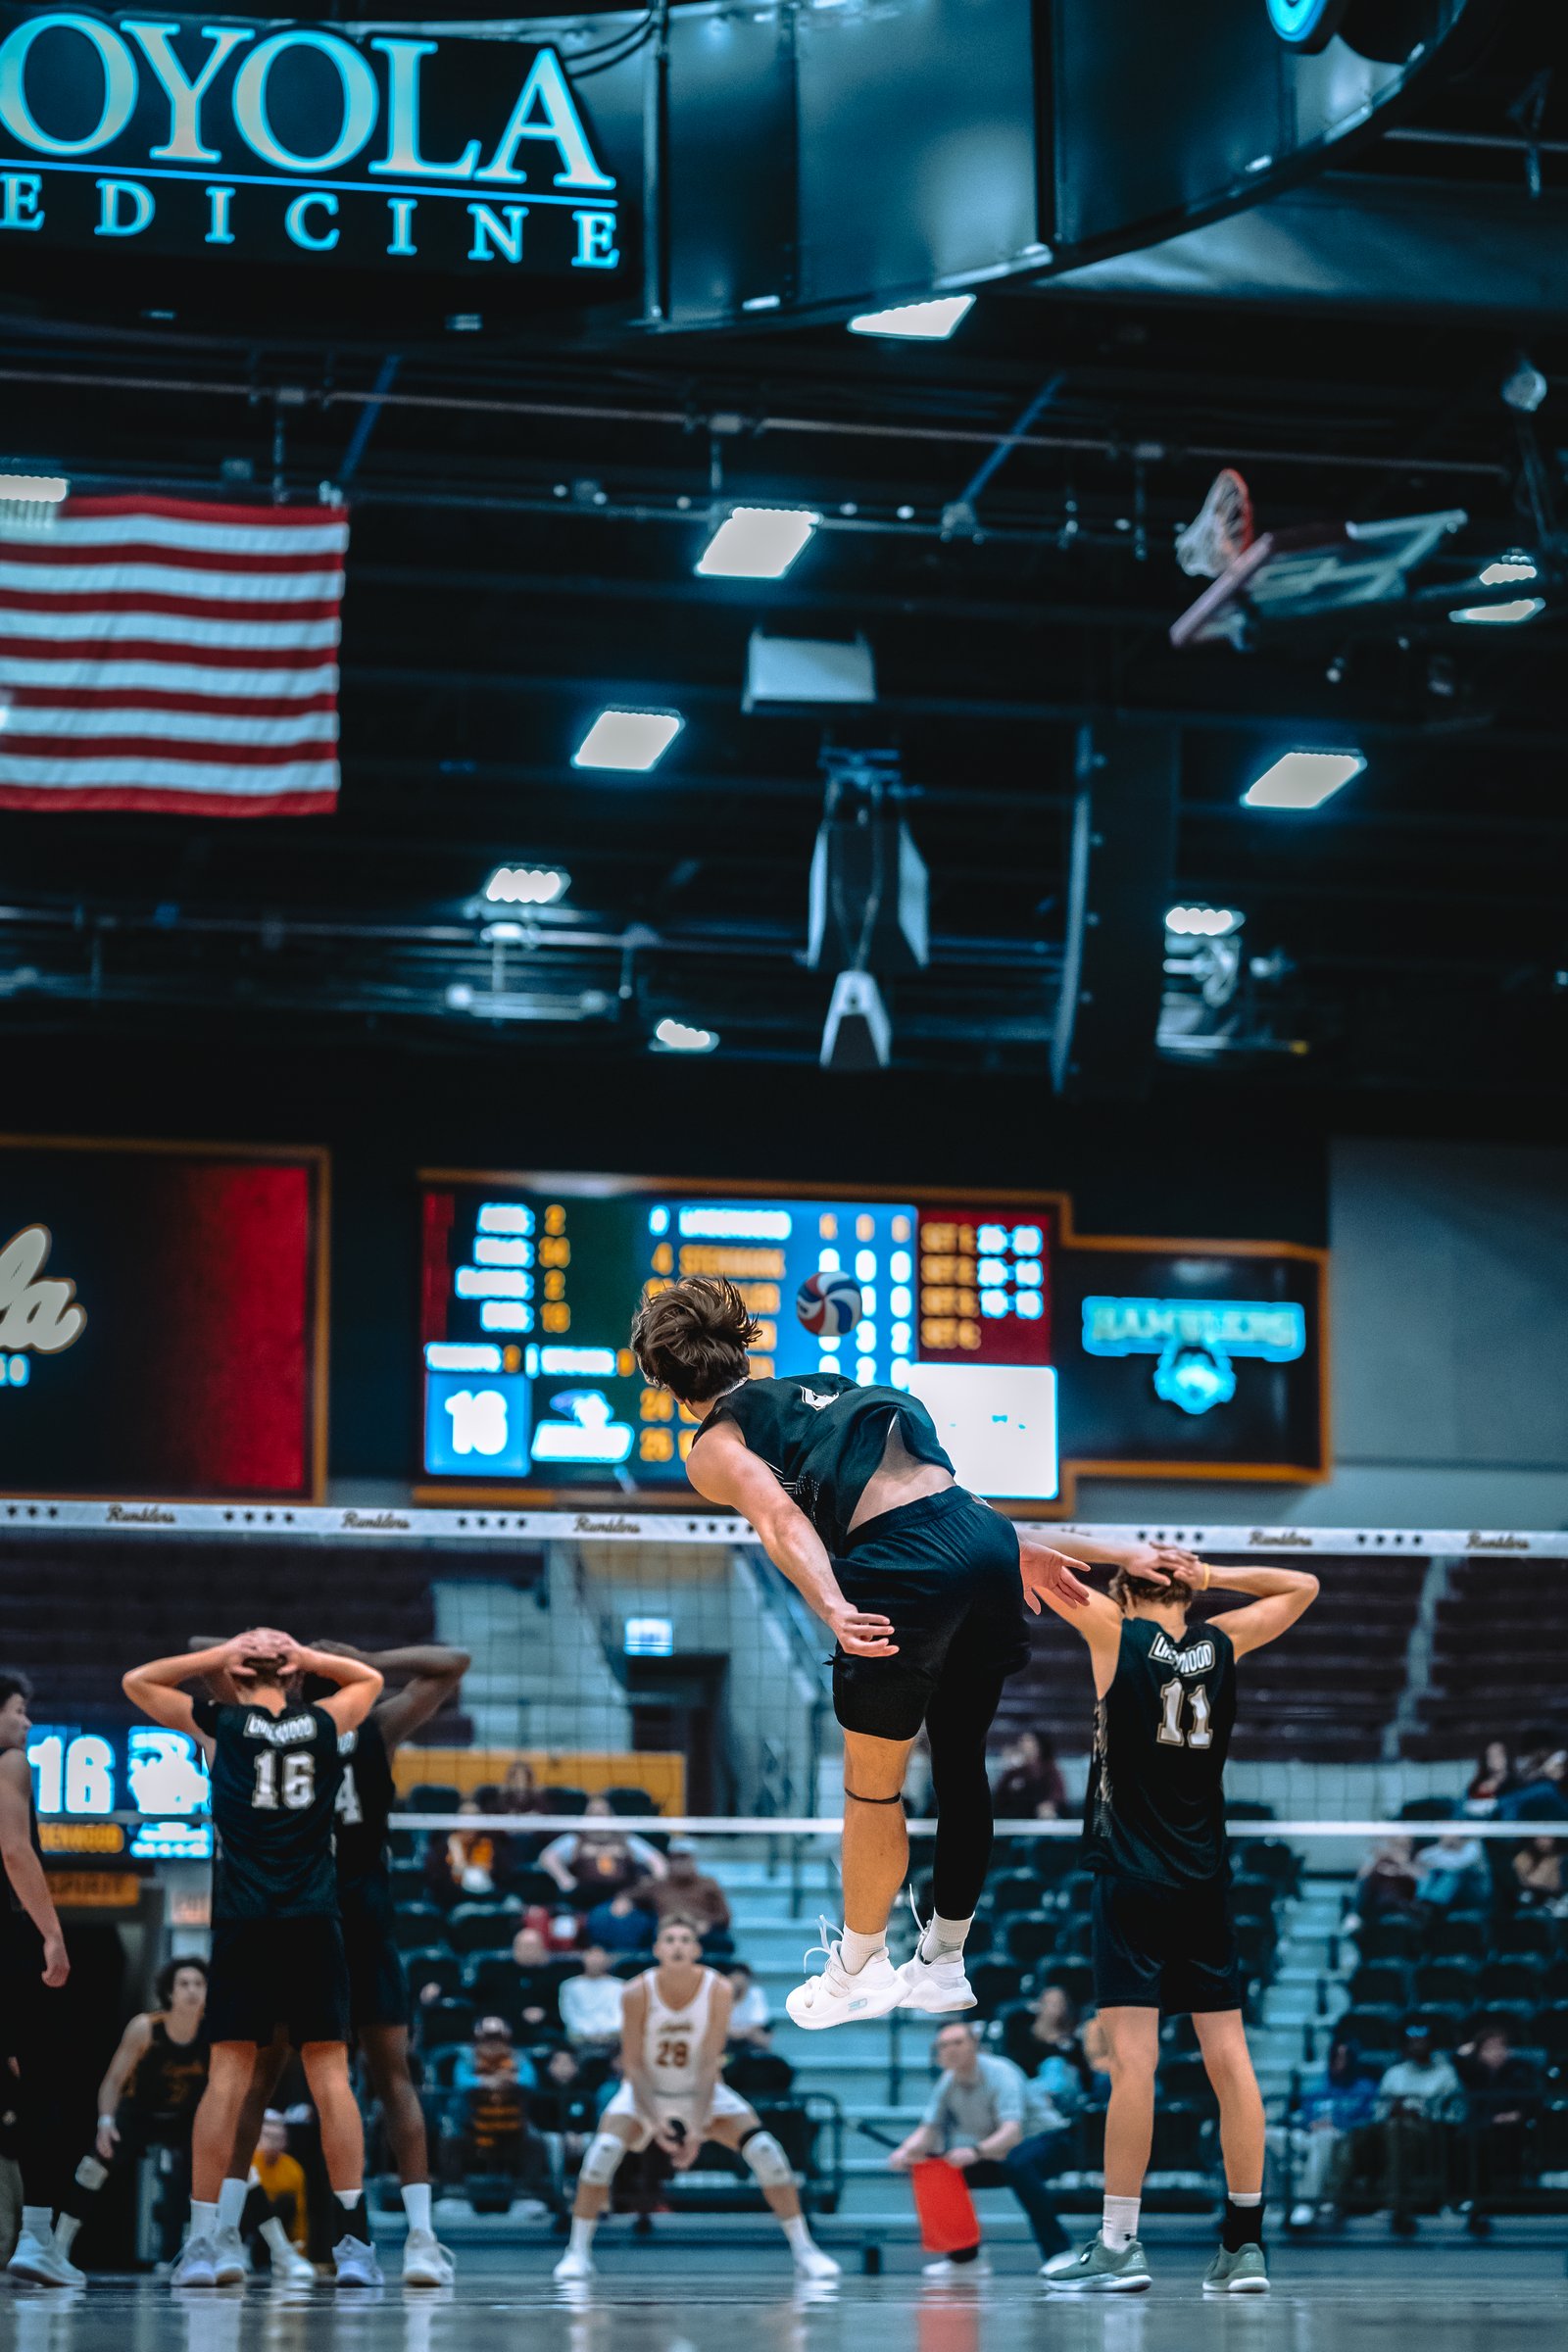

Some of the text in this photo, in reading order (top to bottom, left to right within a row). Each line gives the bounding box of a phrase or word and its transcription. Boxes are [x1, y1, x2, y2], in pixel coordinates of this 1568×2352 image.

[0, 13, 616, 190] OYOLA
[0, 172, 620, 269] EDICINE
[1157, 1678, 1213, 1749] 11
[252, 1749, 316, 1809] 16
